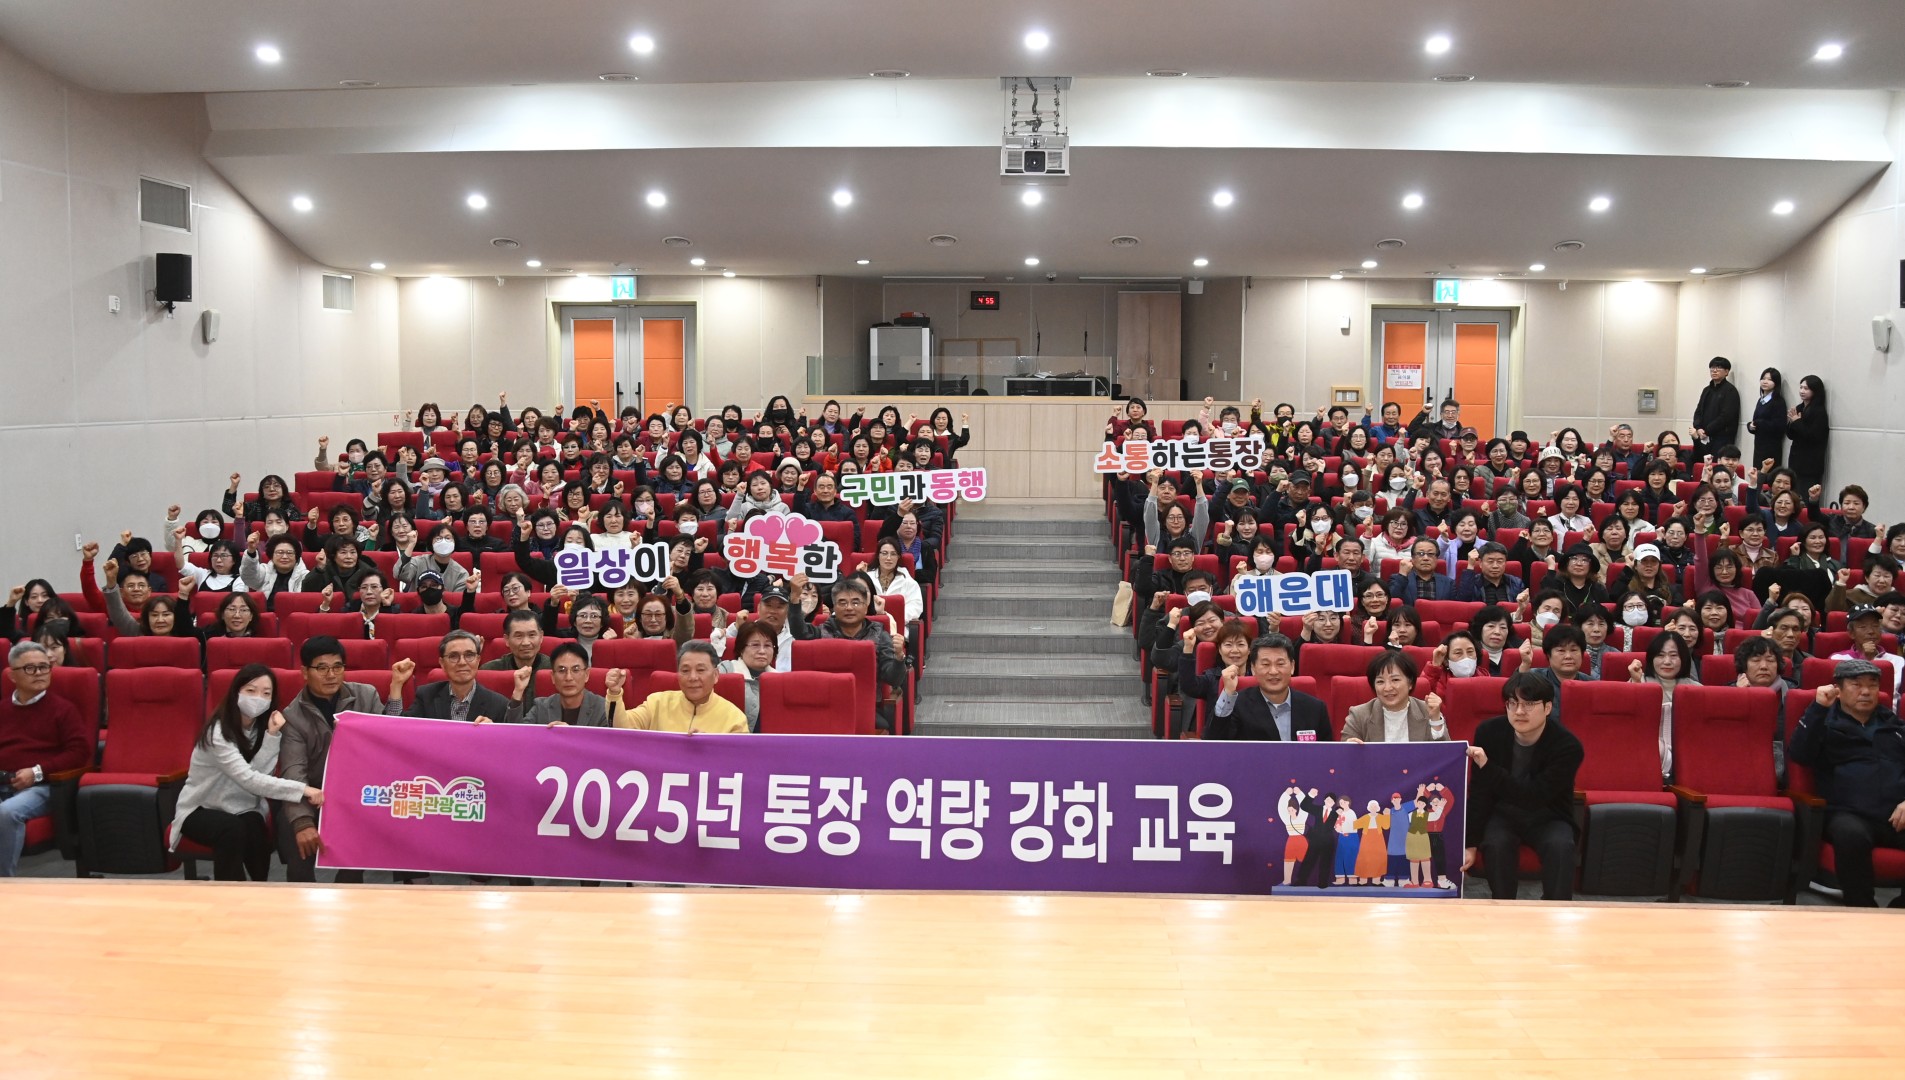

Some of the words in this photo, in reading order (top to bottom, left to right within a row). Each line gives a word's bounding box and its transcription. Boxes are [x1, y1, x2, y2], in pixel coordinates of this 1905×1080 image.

[557, 545, 667, 586] 일상이
[727, 536, 839, 579] 행복한
[1238, 573, 1350, 613] 해운대
[535, 765, 743, 850] 2025년
[763, 775, 867, 856] 통장
[886, 778, 990, 861] 역량
[1009, 781, 1113, 864] 강화
[1132, 782, 1235, 865] 교육
